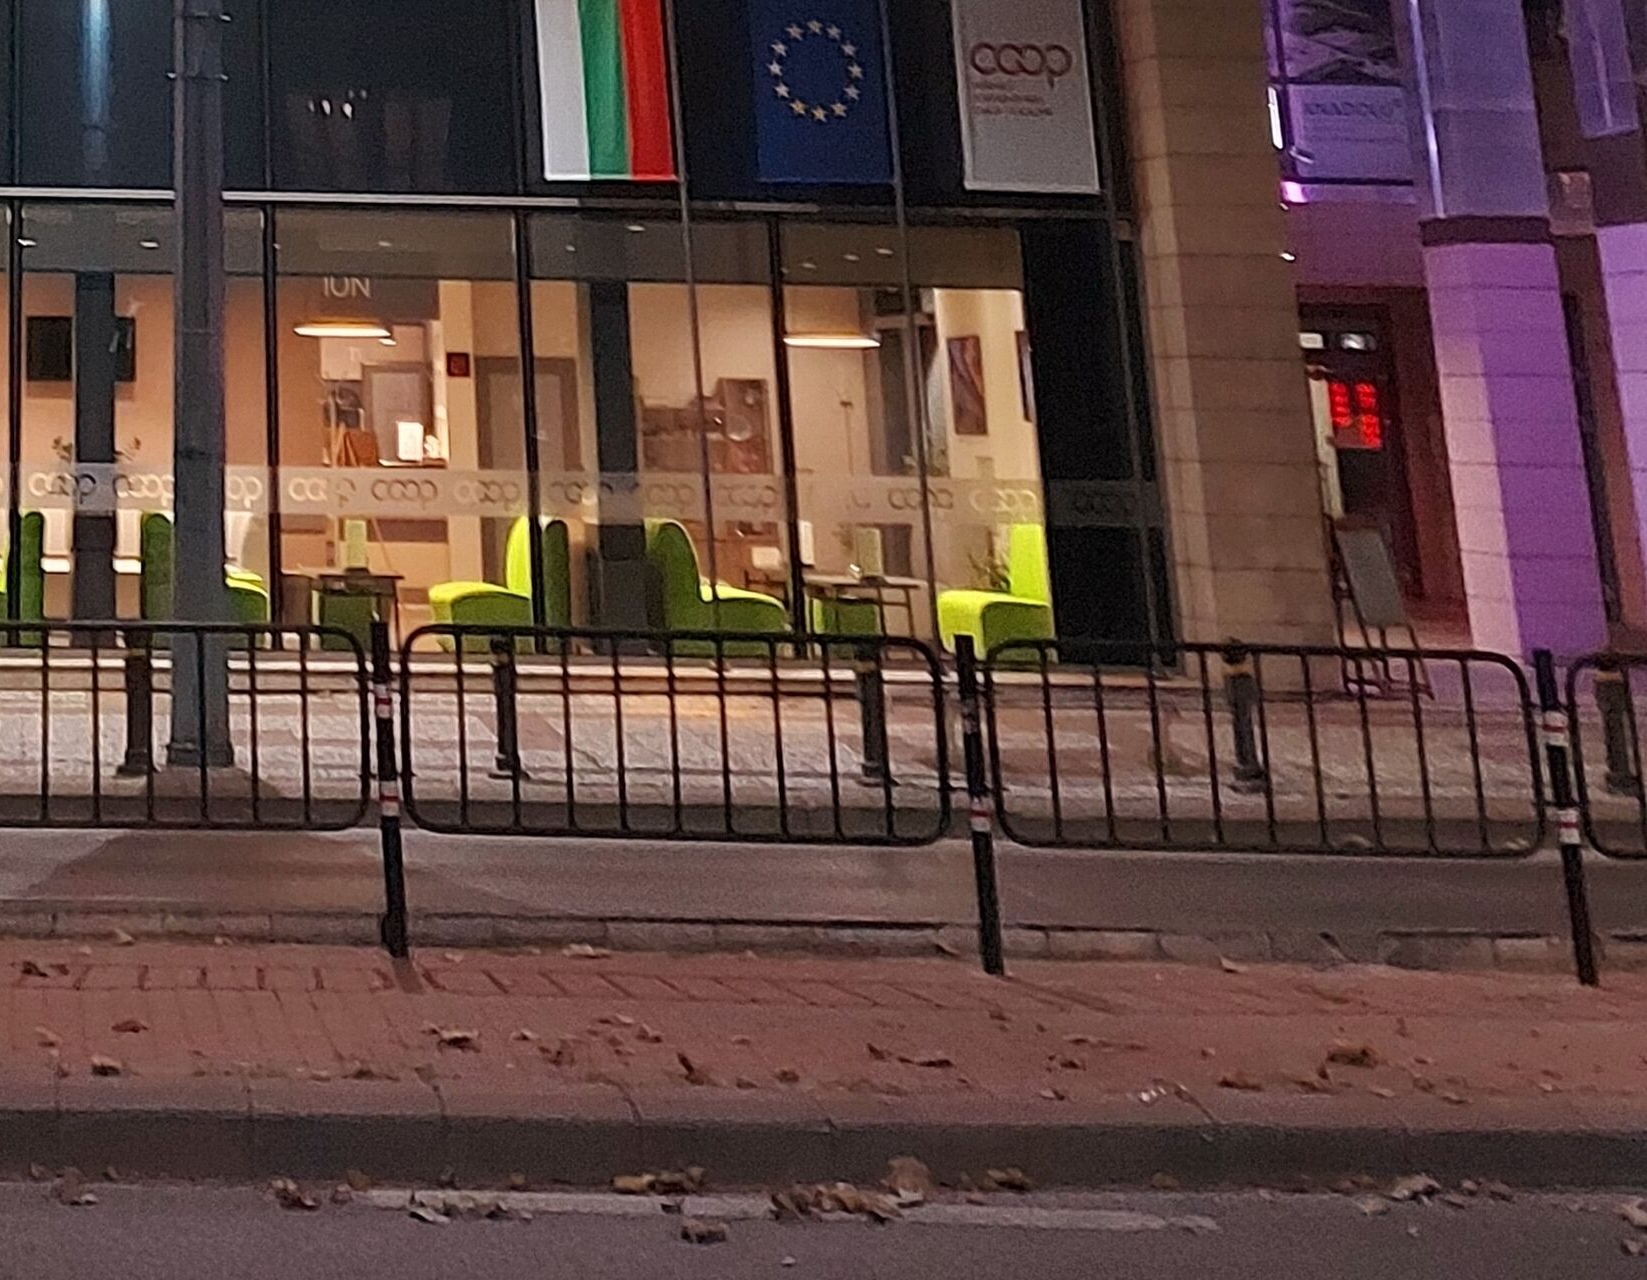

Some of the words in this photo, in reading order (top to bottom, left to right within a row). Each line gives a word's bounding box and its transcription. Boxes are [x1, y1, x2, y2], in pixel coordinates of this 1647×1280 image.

[970, 42, 1073, 89] coop
[224, 475, 263, 510] op
[371, 478, 439, 511] coop
